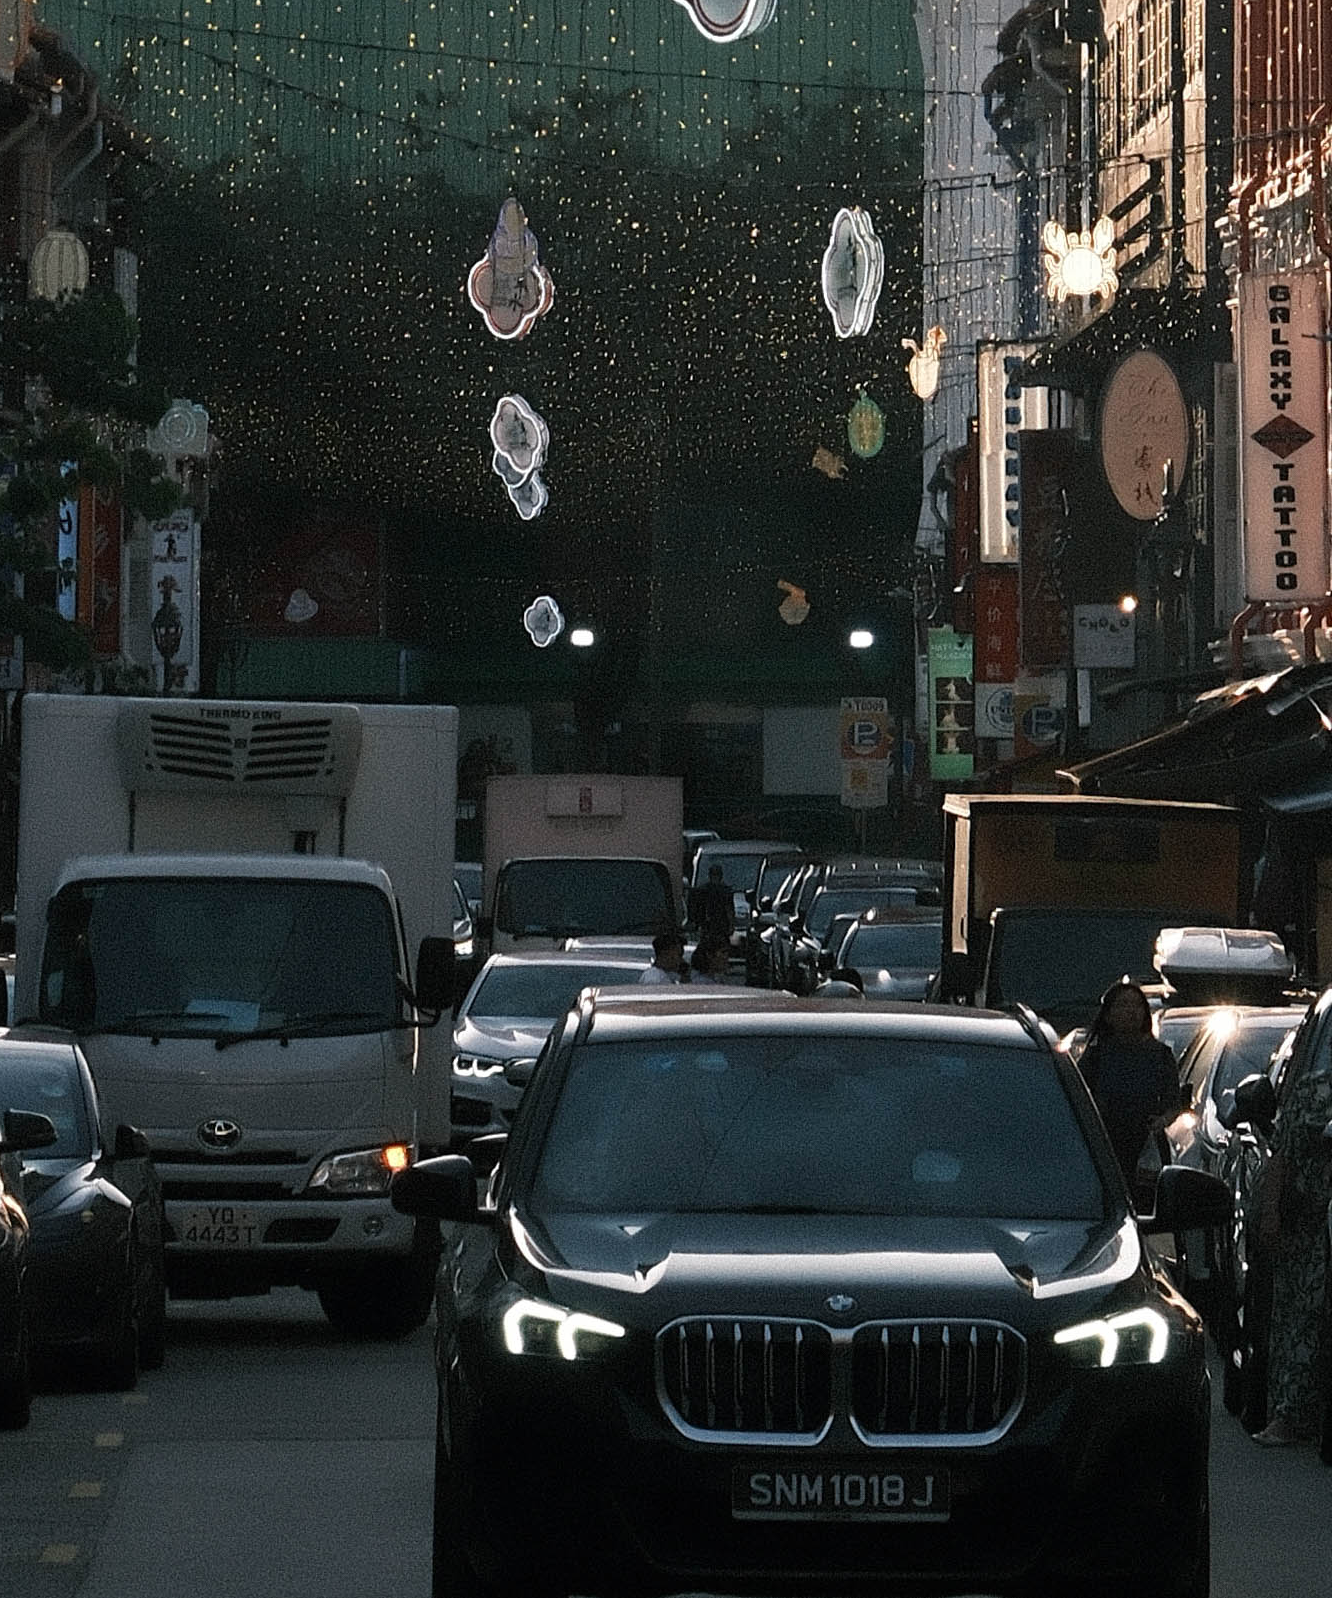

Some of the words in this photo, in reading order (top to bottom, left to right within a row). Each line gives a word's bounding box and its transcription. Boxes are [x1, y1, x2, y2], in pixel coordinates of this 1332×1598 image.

[1268, 284, 1293, 411] GALAXY
[1272, 463, 1298, 591] TATTOO
[207, 1207, 234, 1225] YQ
